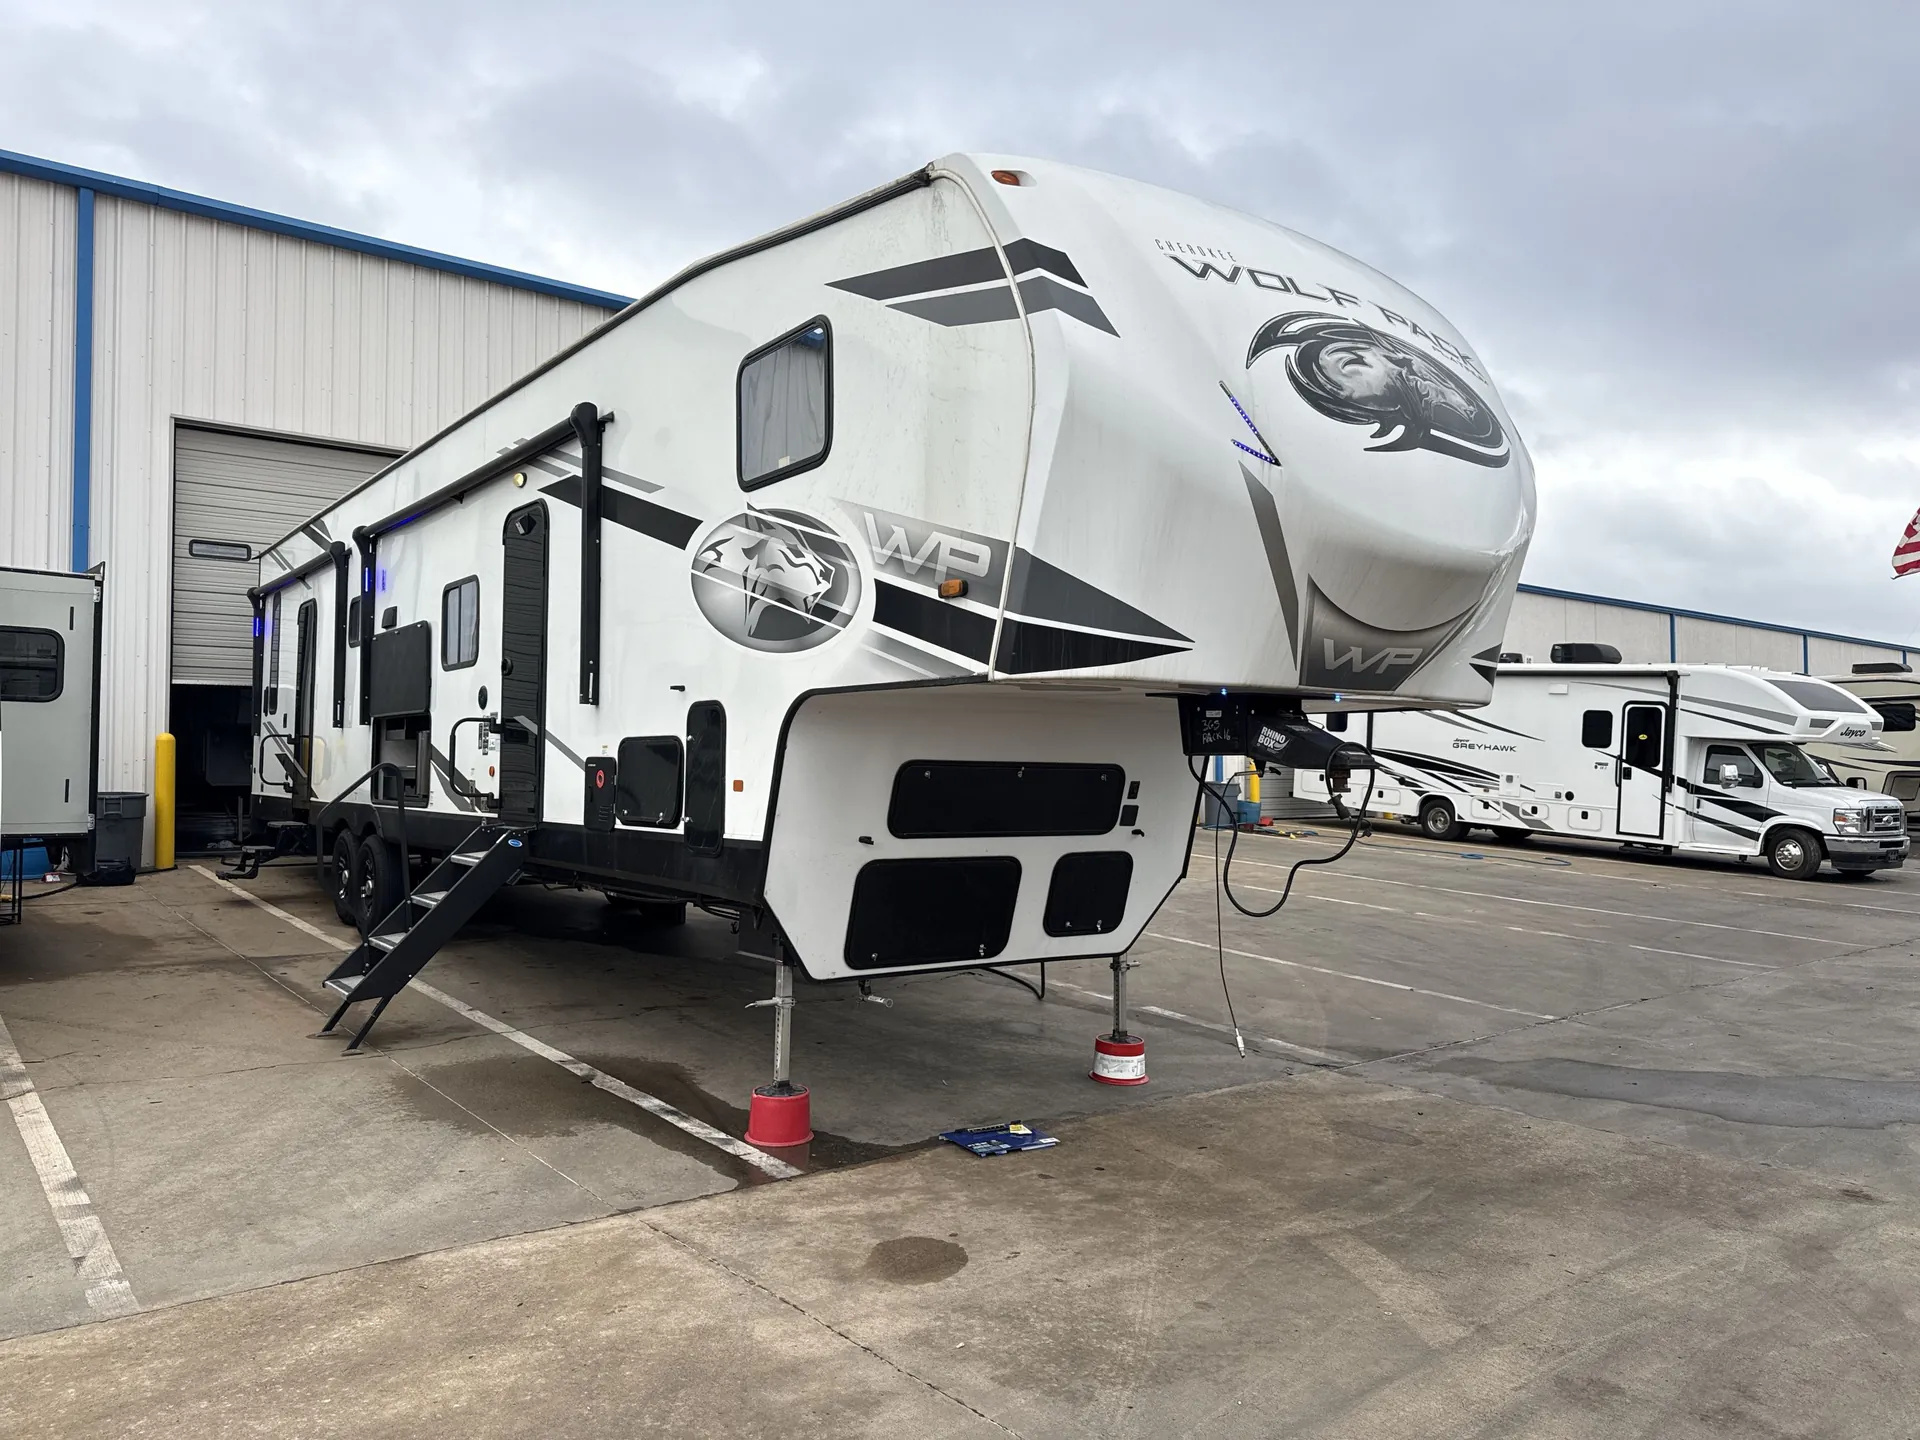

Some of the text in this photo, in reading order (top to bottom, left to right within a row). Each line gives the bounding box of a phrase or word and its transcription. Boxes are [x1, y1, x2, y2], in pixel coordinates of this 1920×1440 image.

[1154, 238, 1237, 263] CHEROKEE
[1163, 253, 1362, 308] WOLF
[1367, 300, 1486, 380] PACK
[864, 511, 992, 585] WP
[1323, 637, 1423, 675] WP
[1257, 734, 1276, 749] BOX
[1261, 726, 1286, 744] RHINO
[1840, 726, 1867, 739] Jayco
[1452, 742, 1517, 753] GREYHAWK
